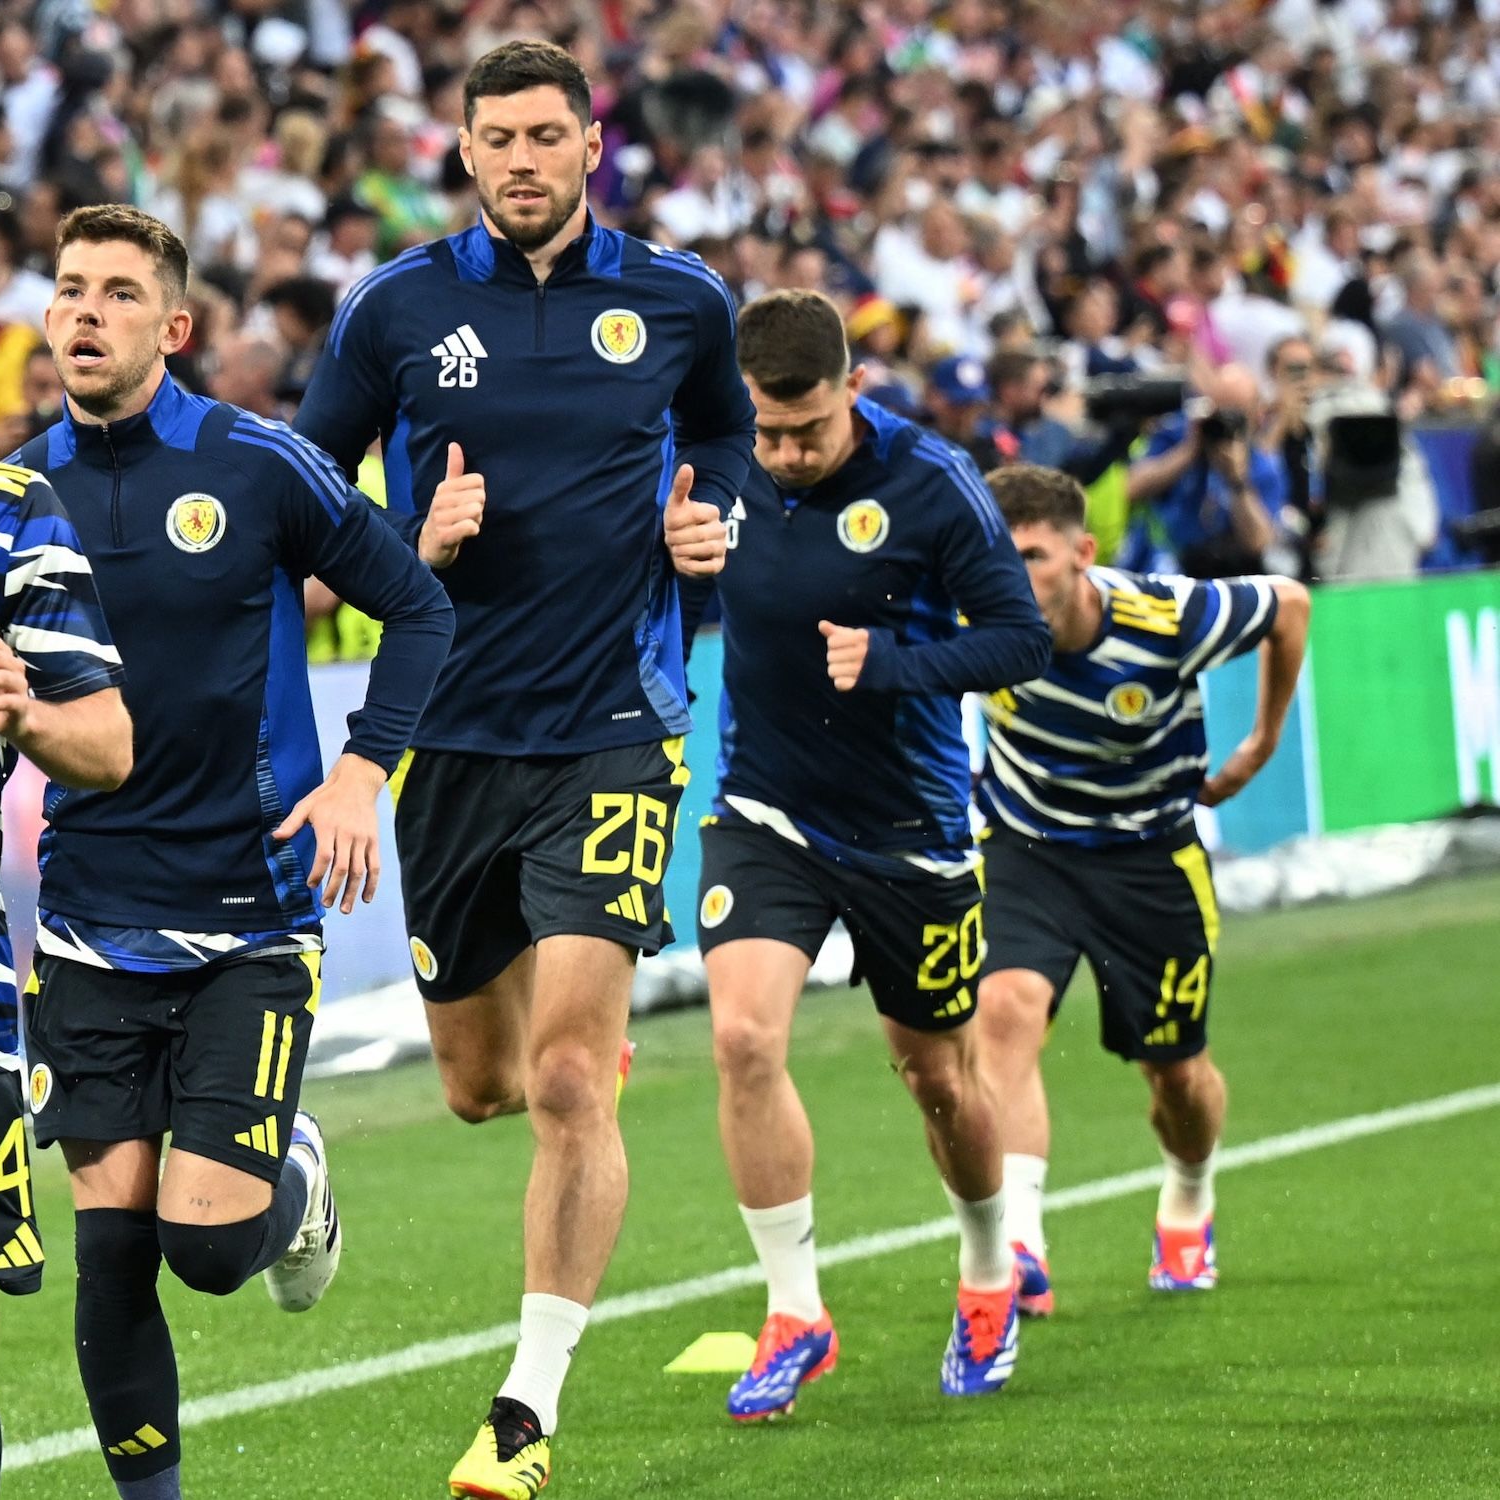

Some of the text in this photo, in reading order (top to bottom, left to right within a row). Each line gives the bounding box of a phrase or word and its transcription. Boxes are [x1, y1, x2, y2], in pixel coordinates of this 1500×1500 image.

[438, 355, 478, 388] 26
[581, 793, 667, 886] 26
[917, 901, 983, 990] 20
[1155, 953, 1209, 1021] 14
[253, 1009, 293, 1102] 11
